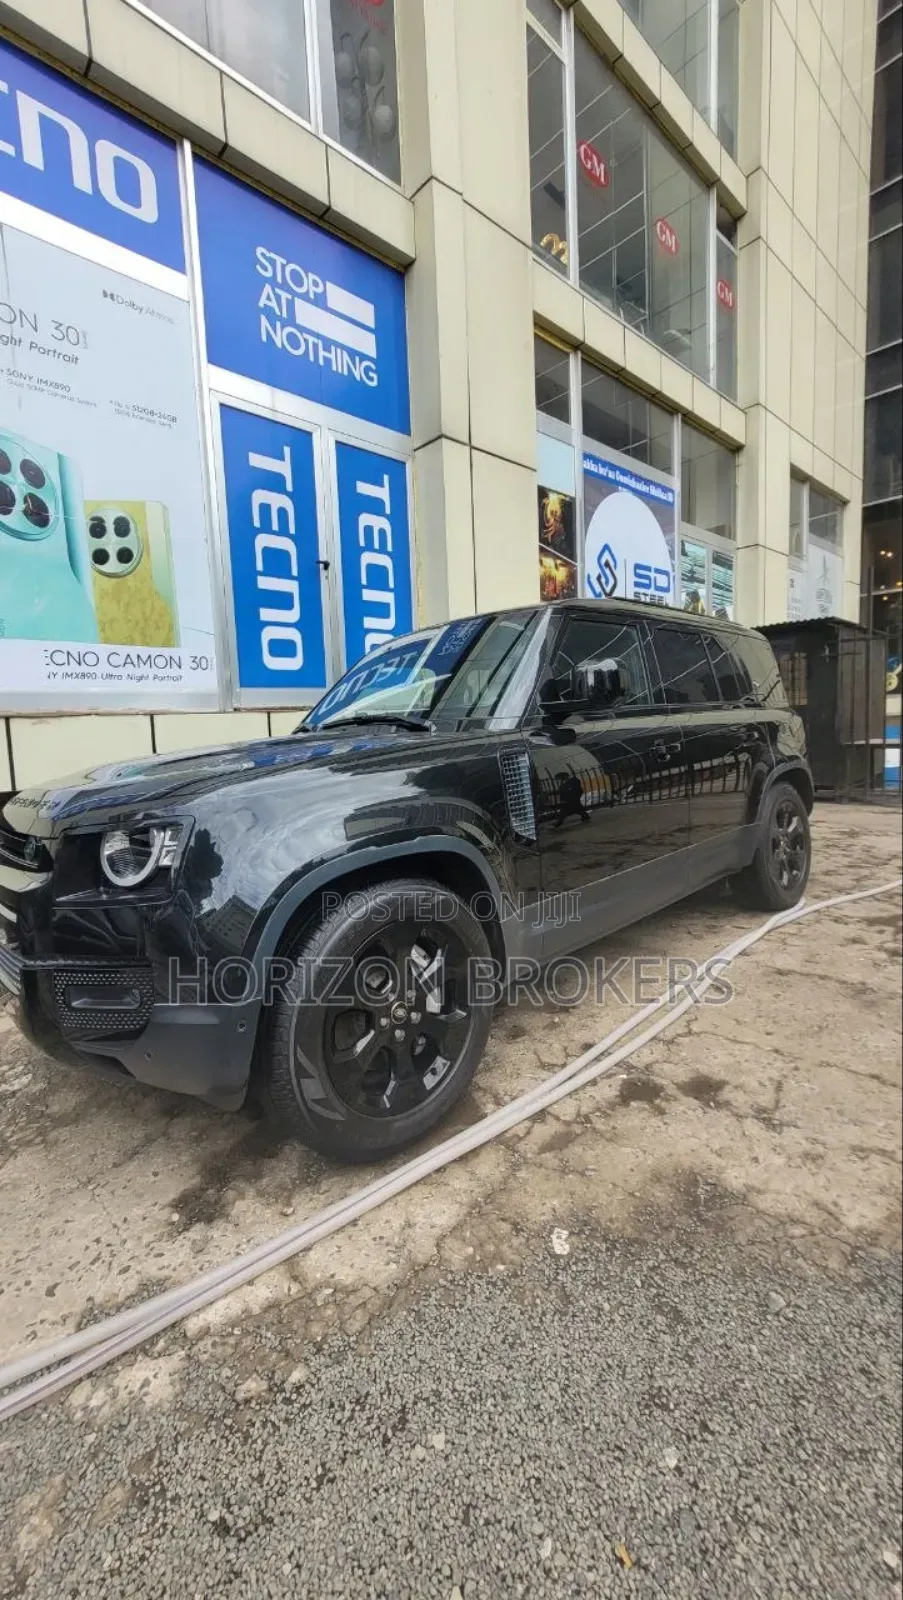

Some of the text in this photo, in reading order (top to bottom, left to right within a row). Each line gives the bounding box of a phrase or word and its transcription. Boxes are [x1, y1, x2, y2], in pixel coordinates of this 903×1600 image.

[0, 80, 158, 223] NO
[580, 144, 606, 185] GM
[656, 220, 676, 253] GM
[255, 246, 325, 299] STOP
[116, 294, 143, 314] Dolby
[258, 283, 292, 318] AT
[717, 280, 733, 307] GM
[51, 319, 80, 346] 30
[29, 341, 79, 365] Portrait
[260, 314, 378, 387] NOTHING
[6, 368, 71, 393] SONY IMX890
[248, 446, 304, 671] TECNO
[634, 562, 671, 593] SD
[107, 652, 182, 669] CAMON
[189, 655, 208, 671] 30
[62, 672, 97, 680] IMX890
[101, 672, 123, 681] Ultra
[127, 673, 149, 683] Night
[153, 673, 182, 682] Portrait
